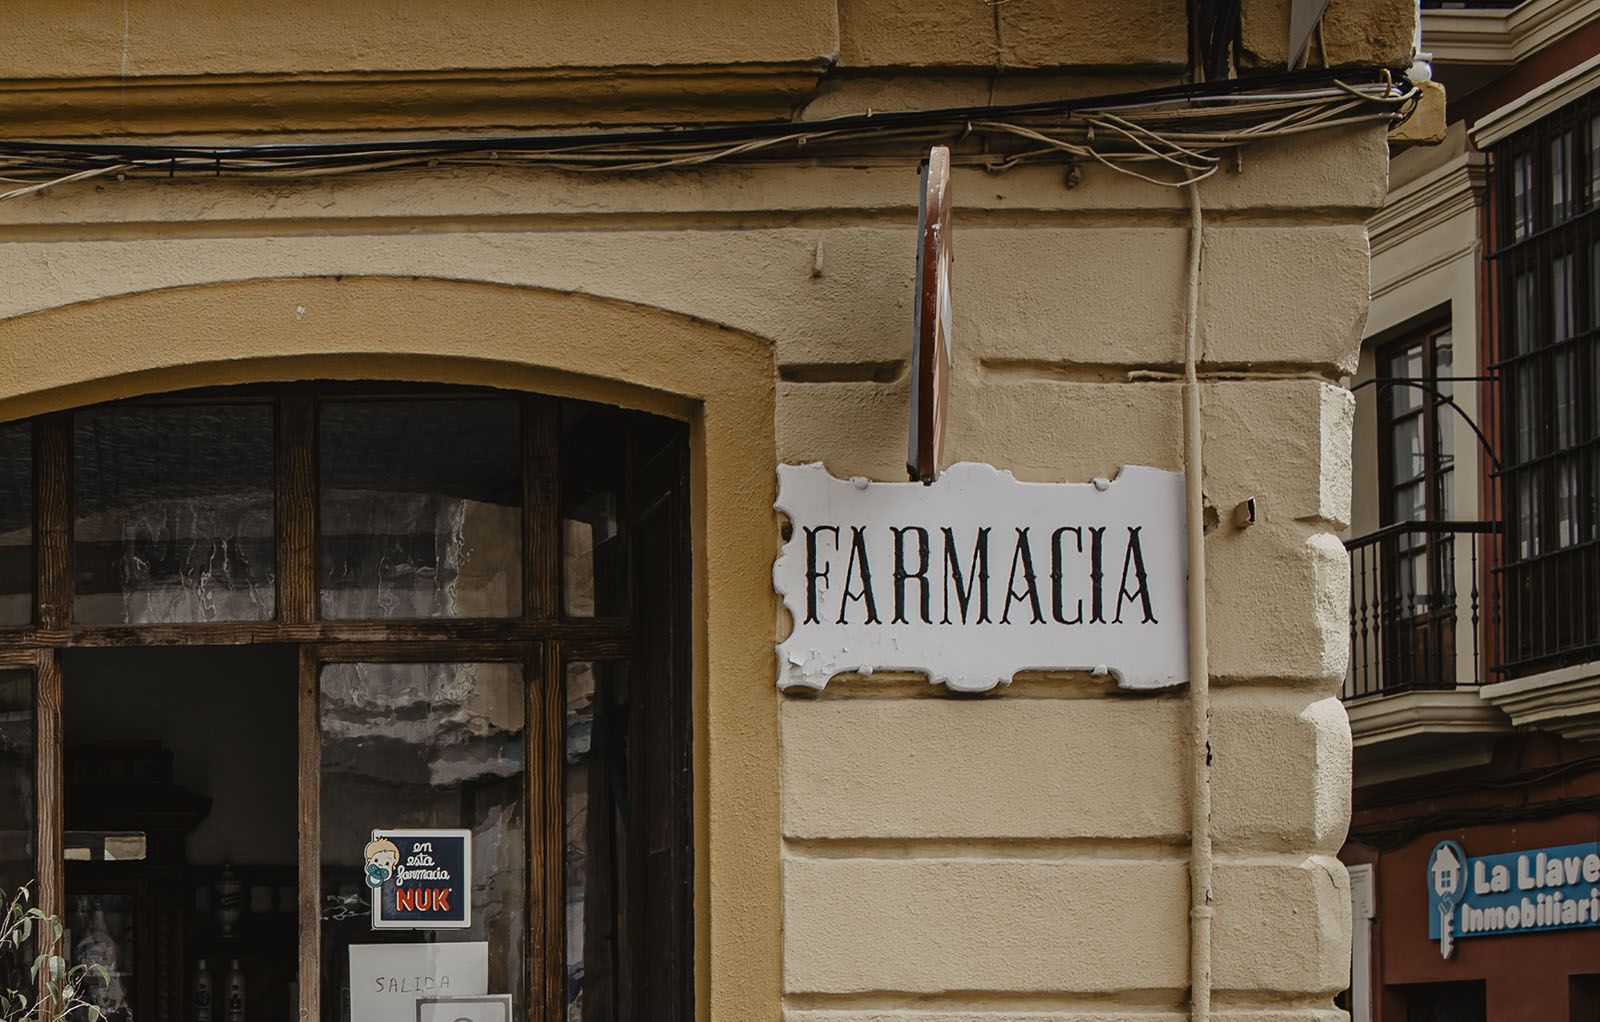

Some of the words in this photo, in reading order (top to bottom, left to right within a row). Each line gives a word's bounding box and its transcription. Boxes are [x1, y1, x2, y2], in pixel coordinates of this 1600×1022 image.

[802, 525, 1159, 626] FARMACIA
[412, 842, 433, 853] en
[406, 852, 435, 867] esta
[396, 864, 451, 886] farmacia
[1474, 860, 1510, 895] La
[1517, 852, 1600, 890] Llave
[396, 887, 450, 912] NUK
[1461, 887, 1600, 933] Inmobiliari
[375, 975, 450, 993] SALIDA
